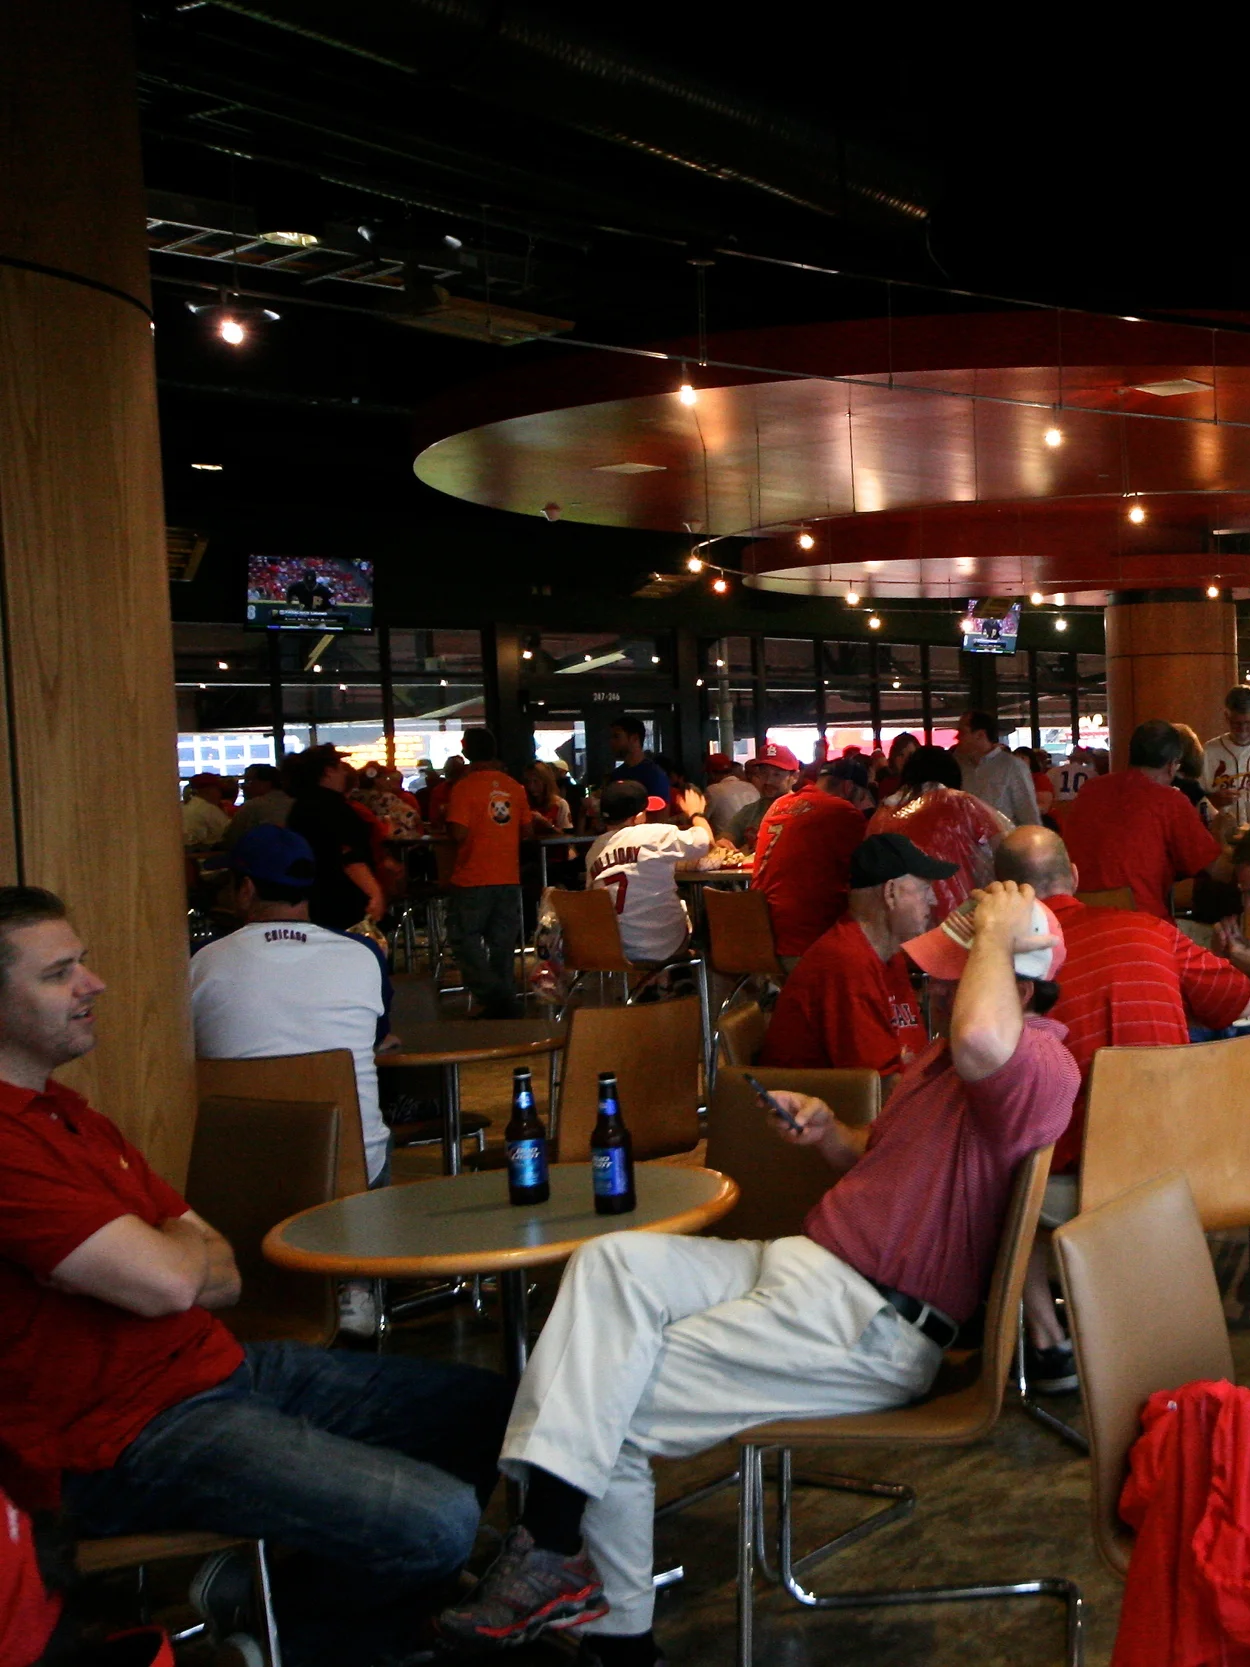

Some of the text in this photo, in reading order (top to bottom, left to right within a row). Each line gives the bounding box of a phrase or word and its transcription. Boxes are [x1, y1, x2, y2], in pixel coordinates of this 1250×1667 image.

[1060, 771, 1088, 793] 10
[603, 872, 628, 915] 7
[264, 929, 307, 943] CHICAGO
